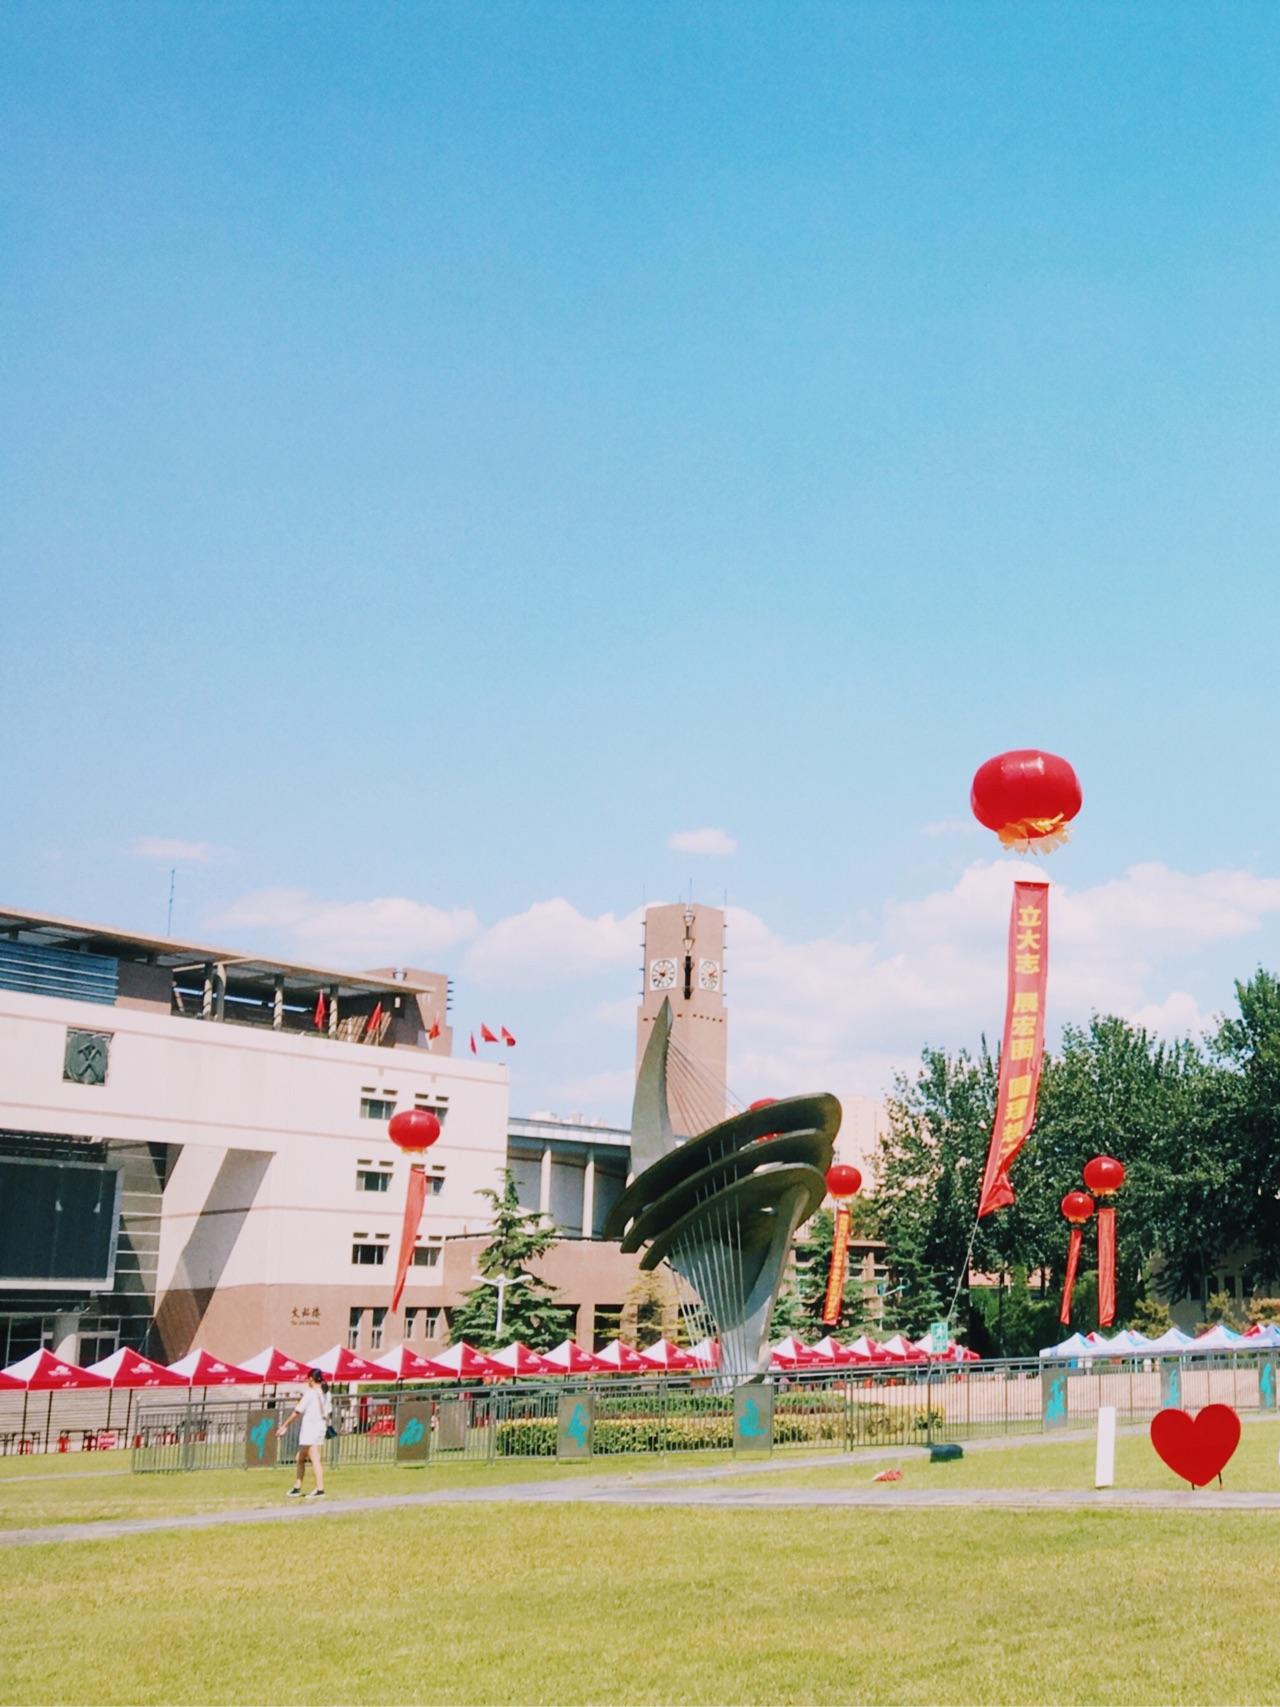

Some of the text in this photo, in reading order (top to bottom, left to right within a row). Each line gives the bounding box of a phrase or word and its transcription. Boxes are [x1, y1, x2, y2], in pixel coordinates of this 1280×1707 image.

[1016, 905, 1041, 974] 立大志
[1095, 1407, 1115, 1487] I
